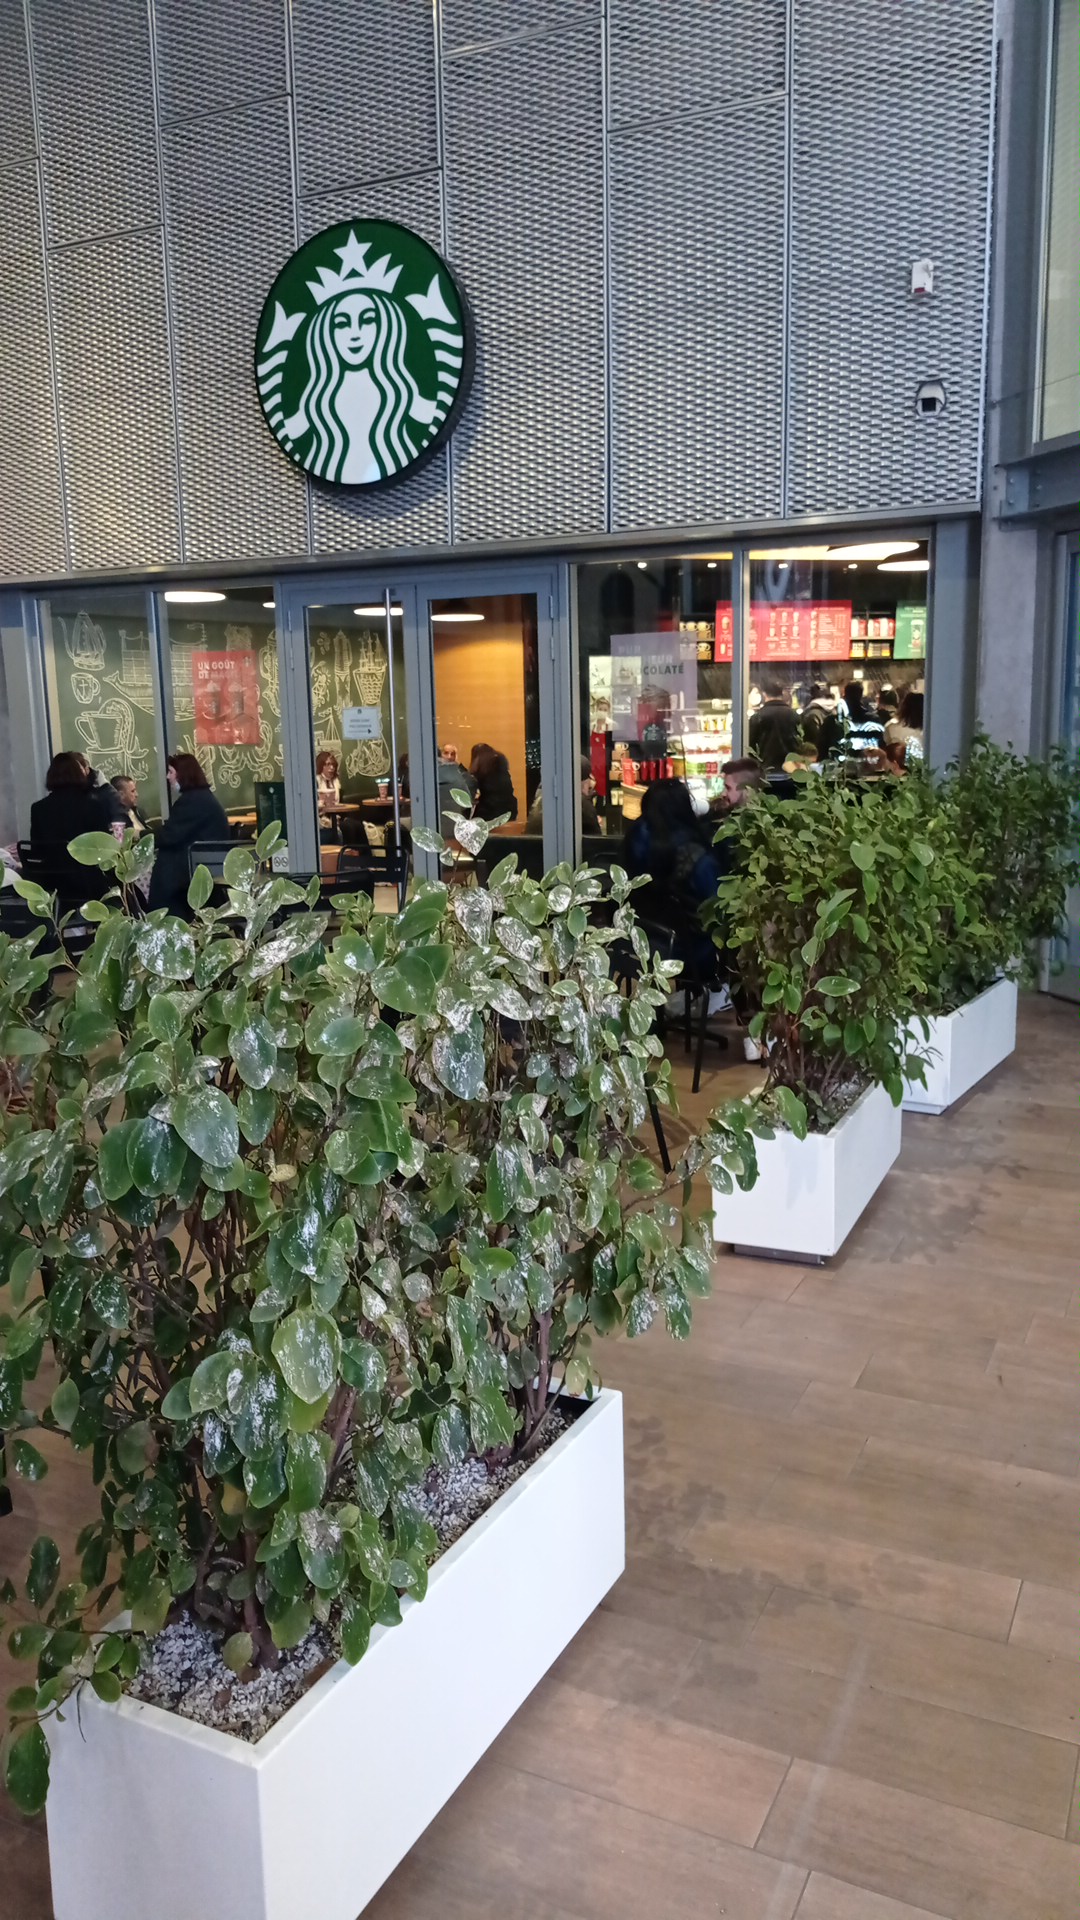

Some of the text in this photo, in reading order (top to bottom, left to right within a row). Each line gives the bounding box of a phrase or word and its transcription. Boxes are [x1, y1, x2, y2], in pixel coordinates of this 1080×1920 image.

[197, 659, 235, 670] UN GOÛT
[643, 662, 684, 676] COLATÉ
[198, 670, 209, 679] DE
